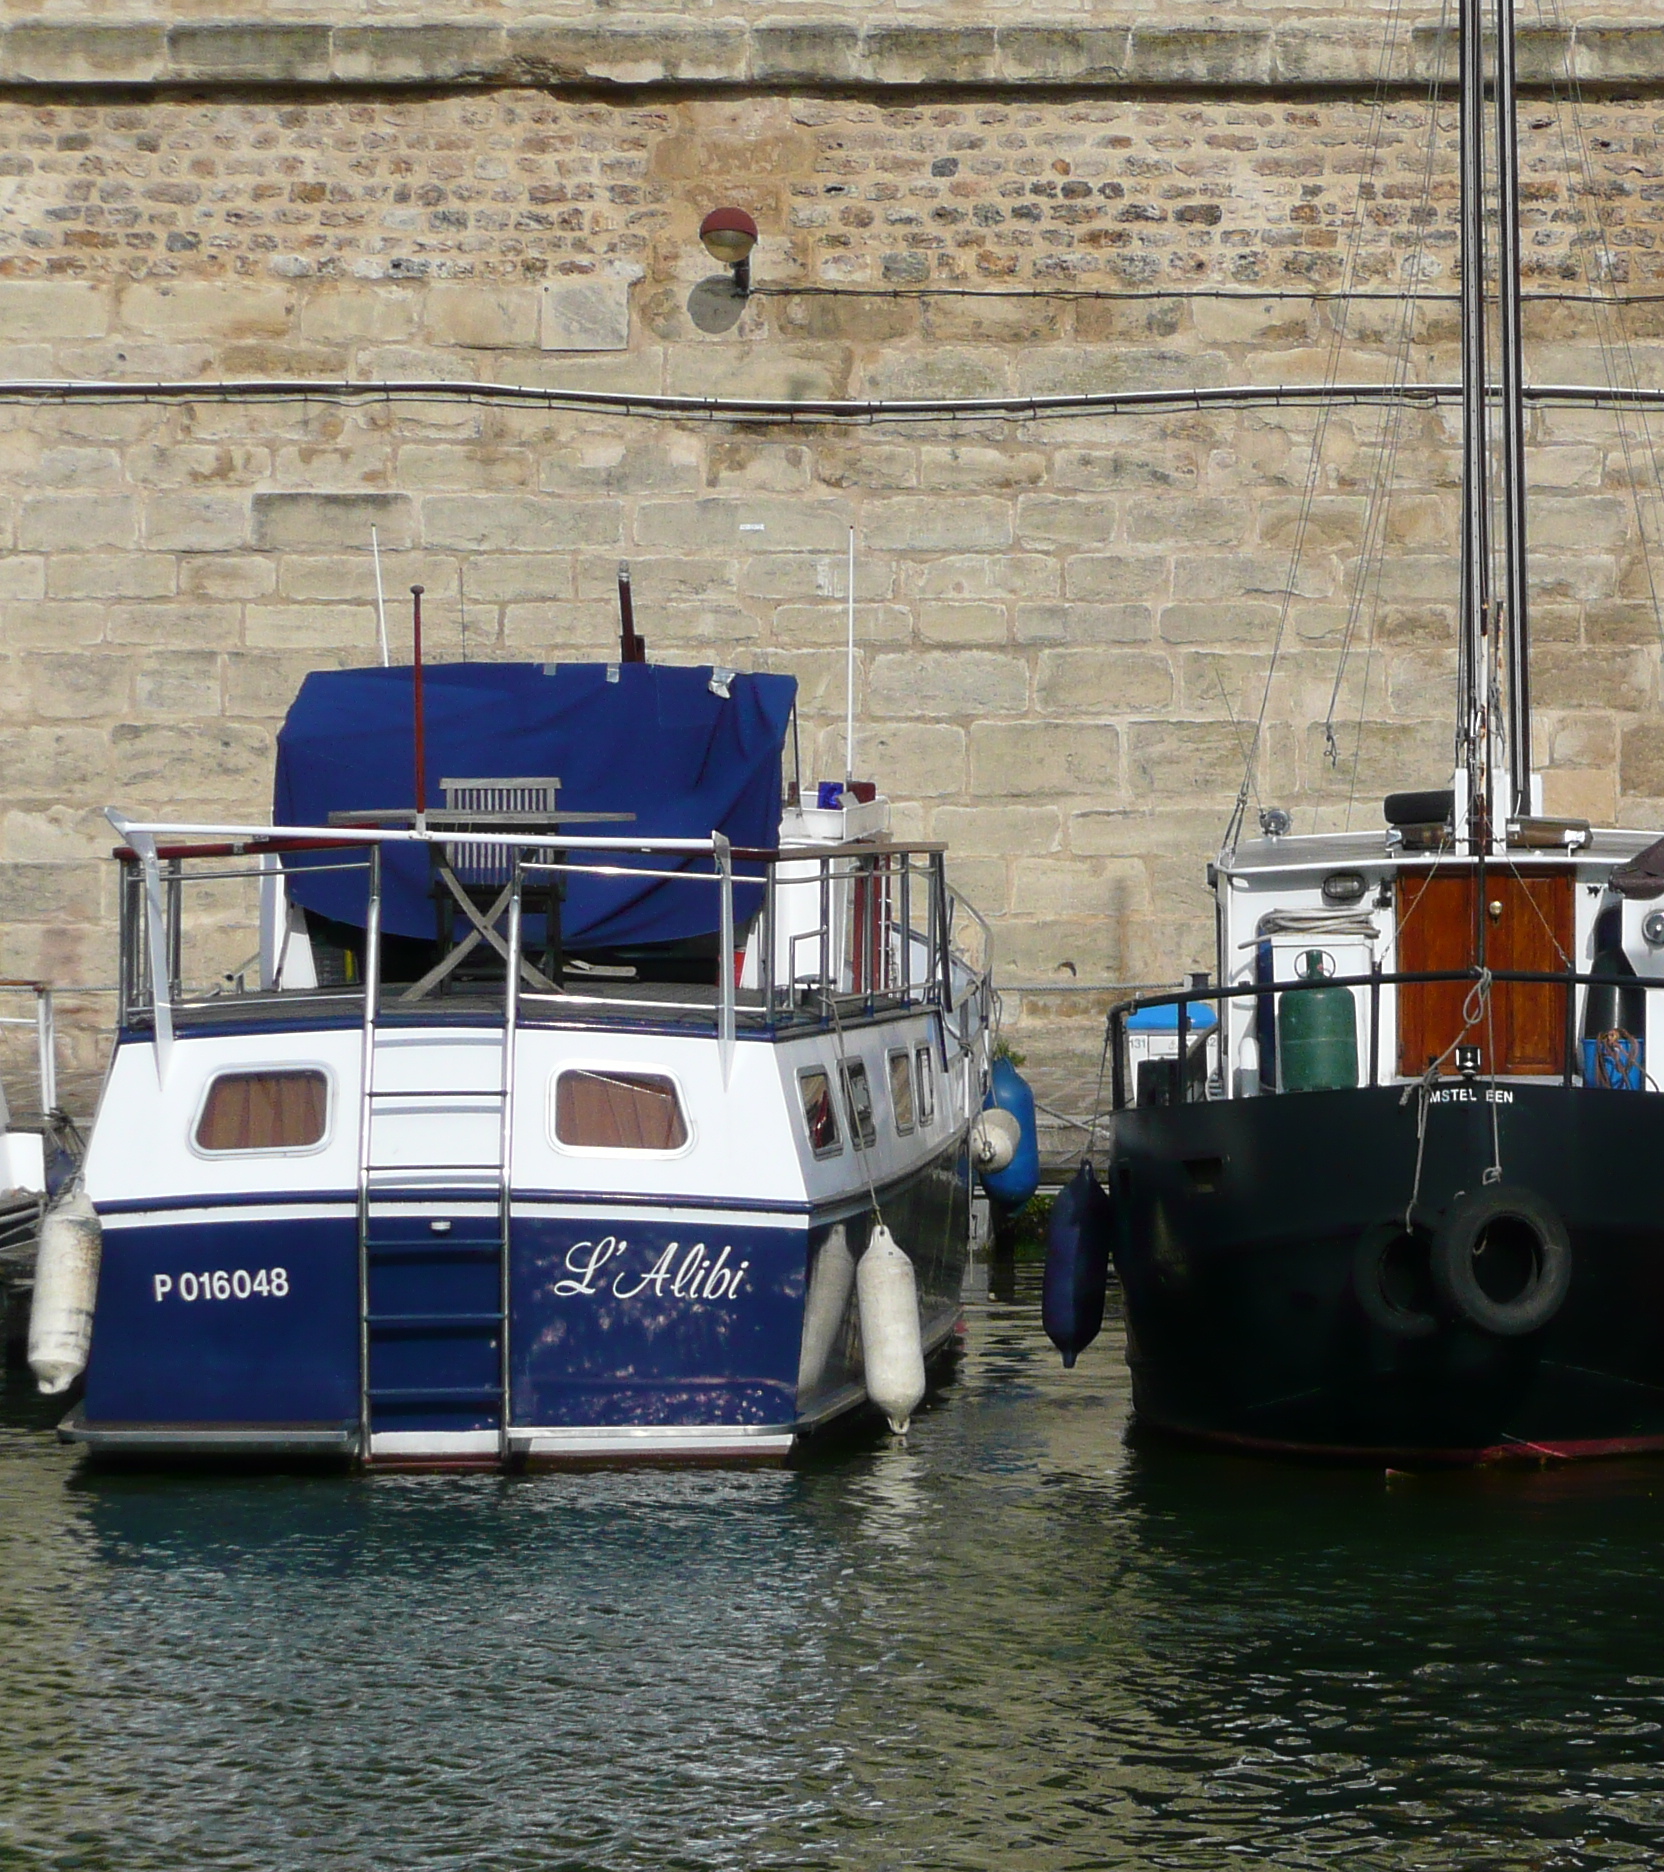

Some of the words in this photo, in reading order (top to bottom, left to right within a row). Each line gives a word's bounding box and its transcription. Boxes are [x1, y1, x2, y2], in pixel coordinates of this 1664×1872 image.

[154, 1273, 172, 1301] P
[180, 1267, 289, 1301] 016048
[554, 1236, 749, 1299] L'Alibi
